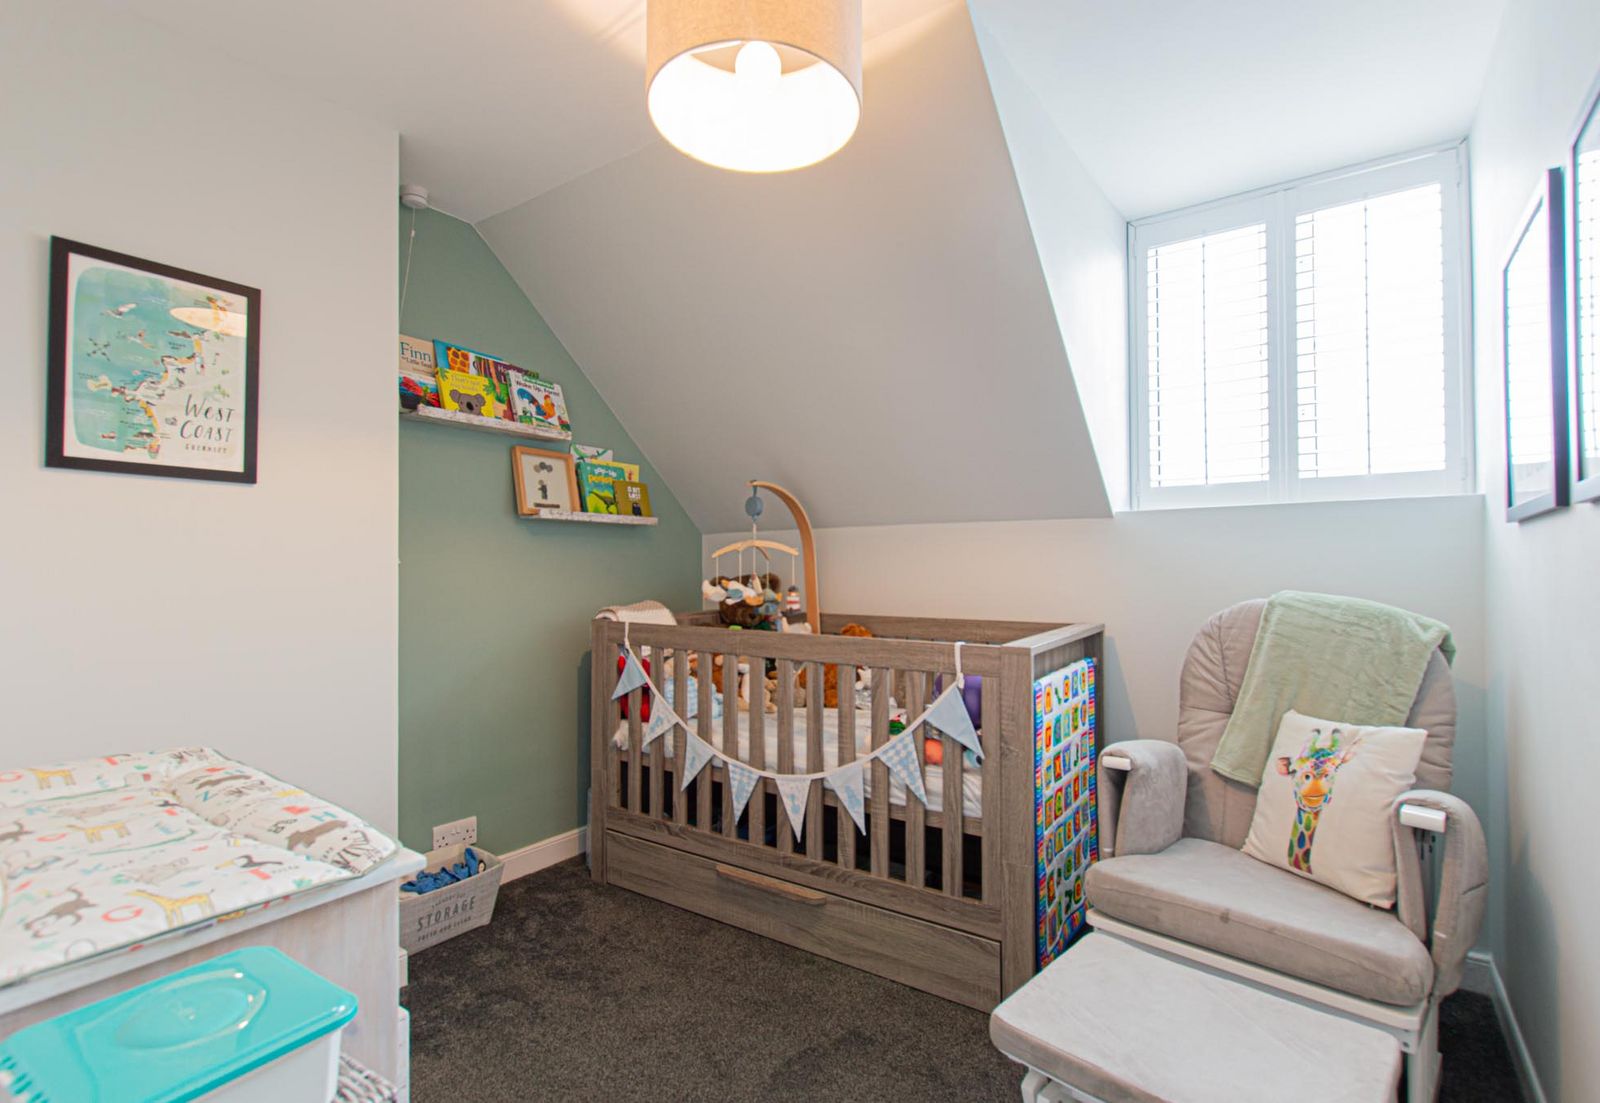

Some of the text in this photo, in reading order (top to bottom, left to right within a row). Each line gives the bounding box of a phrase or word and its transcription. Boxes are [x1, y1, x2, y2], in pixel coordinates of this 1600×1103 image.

[399, 341, 432, 362] Finn
[180, 420, 233, 443] COAST
[416, 895, 477, 932] STORAGE
